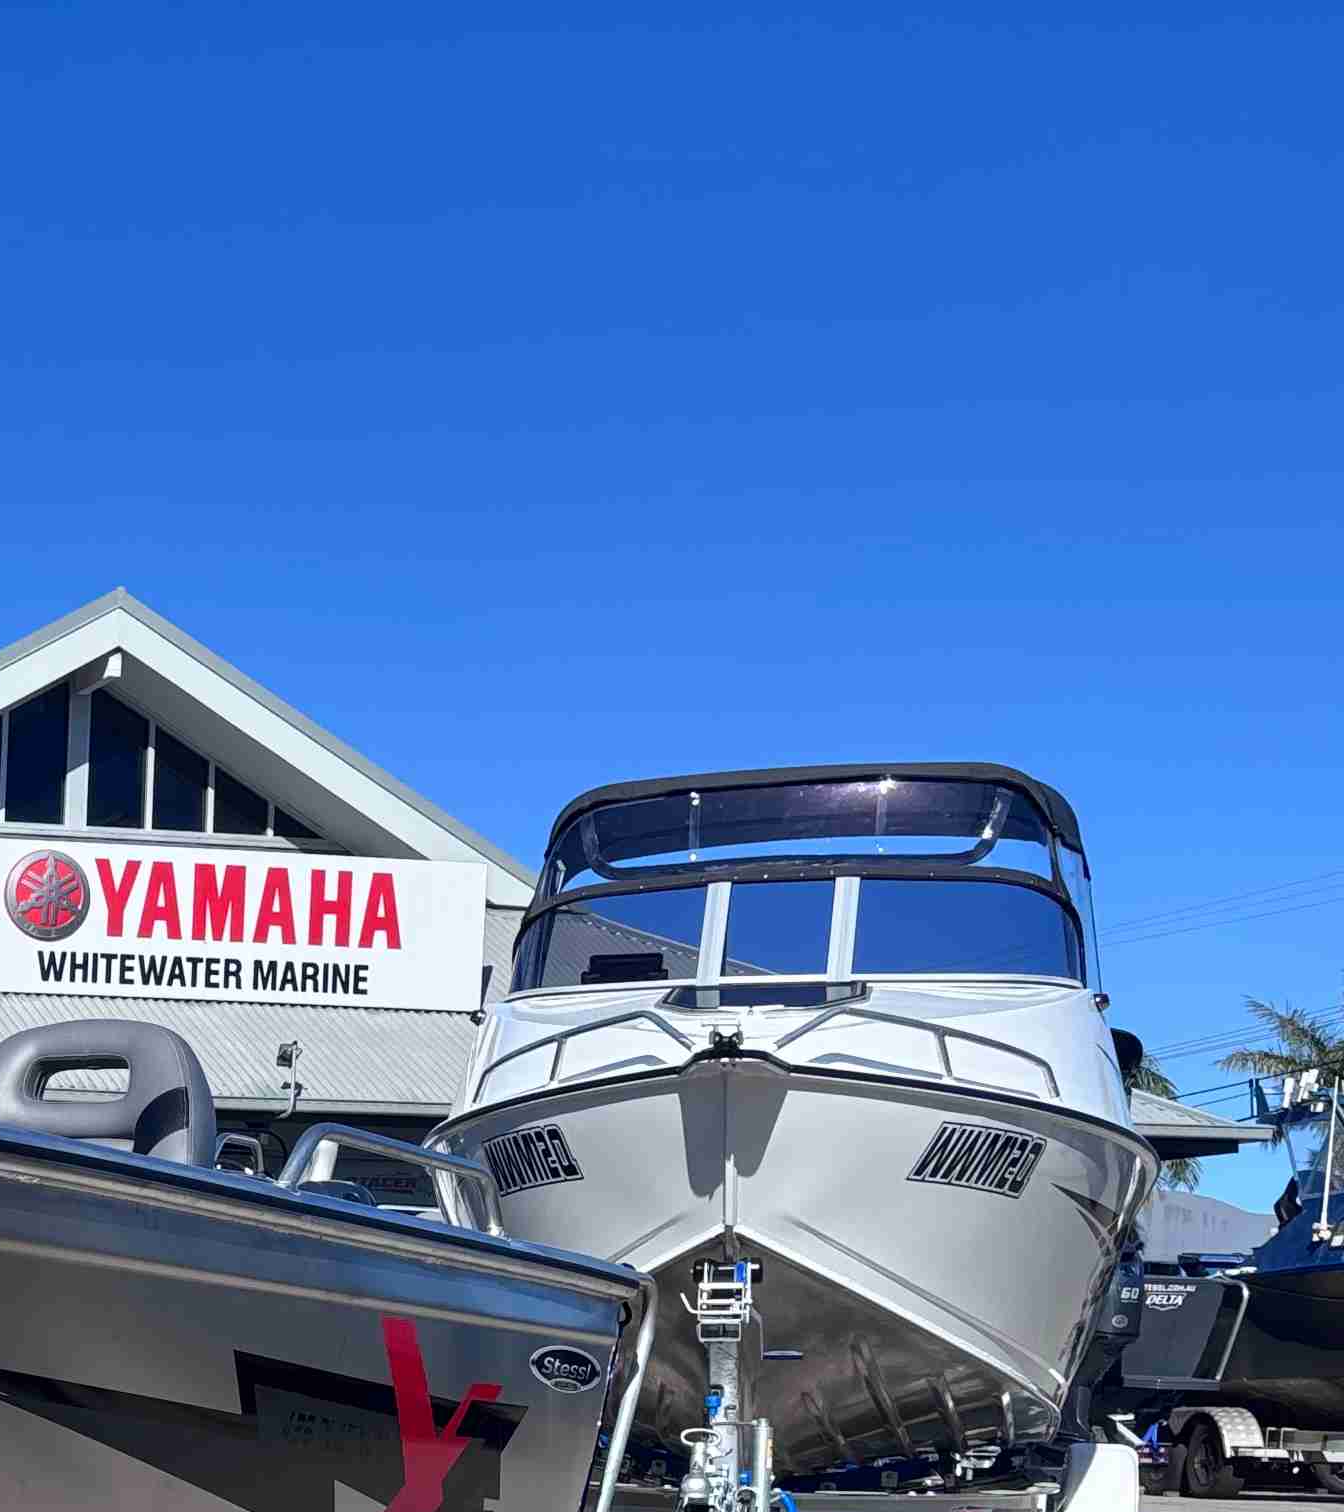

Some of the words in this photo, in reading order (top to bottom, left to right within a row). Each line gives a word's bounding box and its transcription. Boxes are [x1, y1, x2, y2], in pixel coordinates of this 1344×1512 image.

[94, 857, 402, 950] YAMAHA
[37, 949, 243, 990] WHITEWATER
[252, 960, 370, 995] MARINE
[912, 1125, 1045, 1194] WWM120
[1120, 1287, 1140, 1299] 60
[1145, 1294, 1183, 1306] DELTA
[541, 1356, 592, 1380] Stessl
